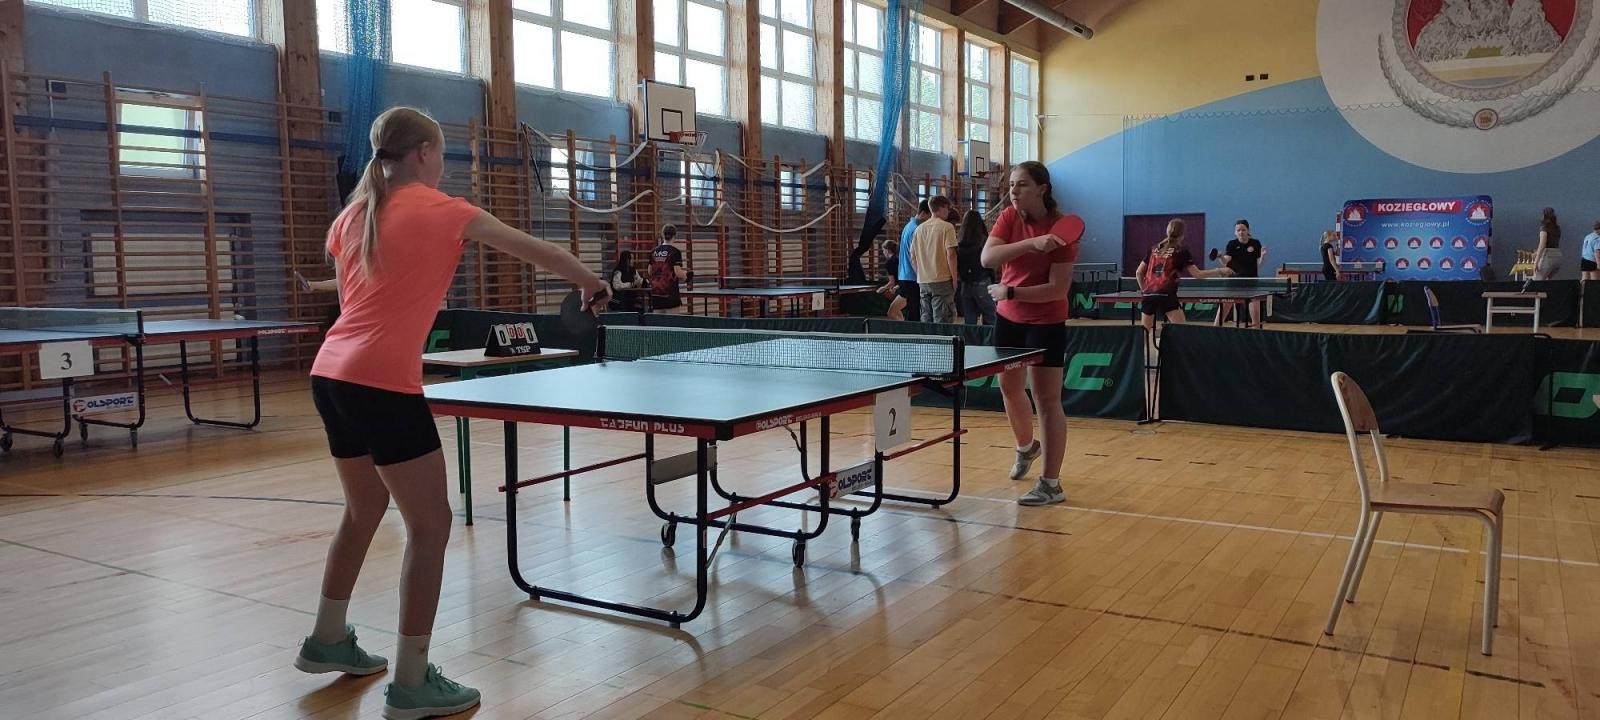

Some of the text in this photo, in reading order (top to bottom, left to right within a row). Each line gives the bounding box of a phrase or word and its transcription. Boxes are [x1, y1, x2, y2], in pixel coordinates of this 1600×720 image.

[1377, 201, 1456, 213] KOZIEGŁOWY
[61, 352, 73, 370] 3
[653, 422, 685, 434] PLUS
[888, 407, 897, 437] 2
